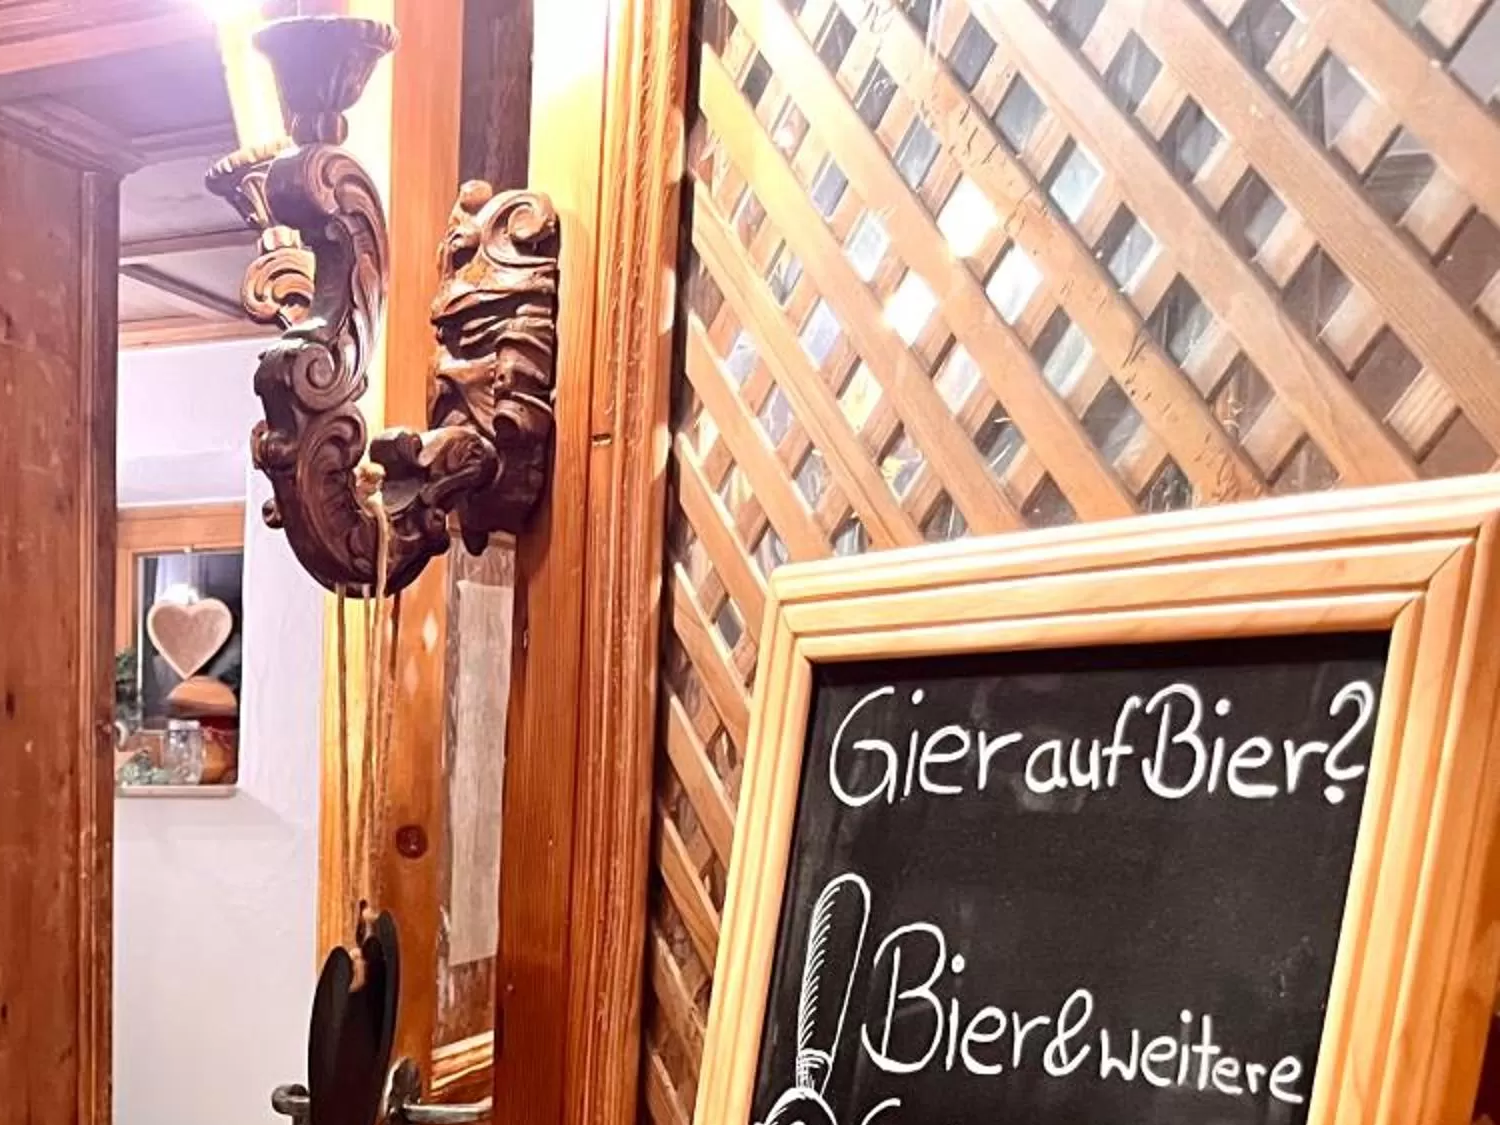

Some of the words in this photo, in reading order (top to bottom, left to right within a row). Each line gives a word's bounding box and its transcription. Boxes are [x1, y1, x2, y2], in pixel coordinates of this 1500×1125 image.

[829, 686, 1022, 806] Gier
[1024, 696, 1141, 793] auf
[1143, 681, 1374, 804] Bier?
[861, 922, 1049, 1075] Bier
[1100, 1010, 1304, 1103] weitere
